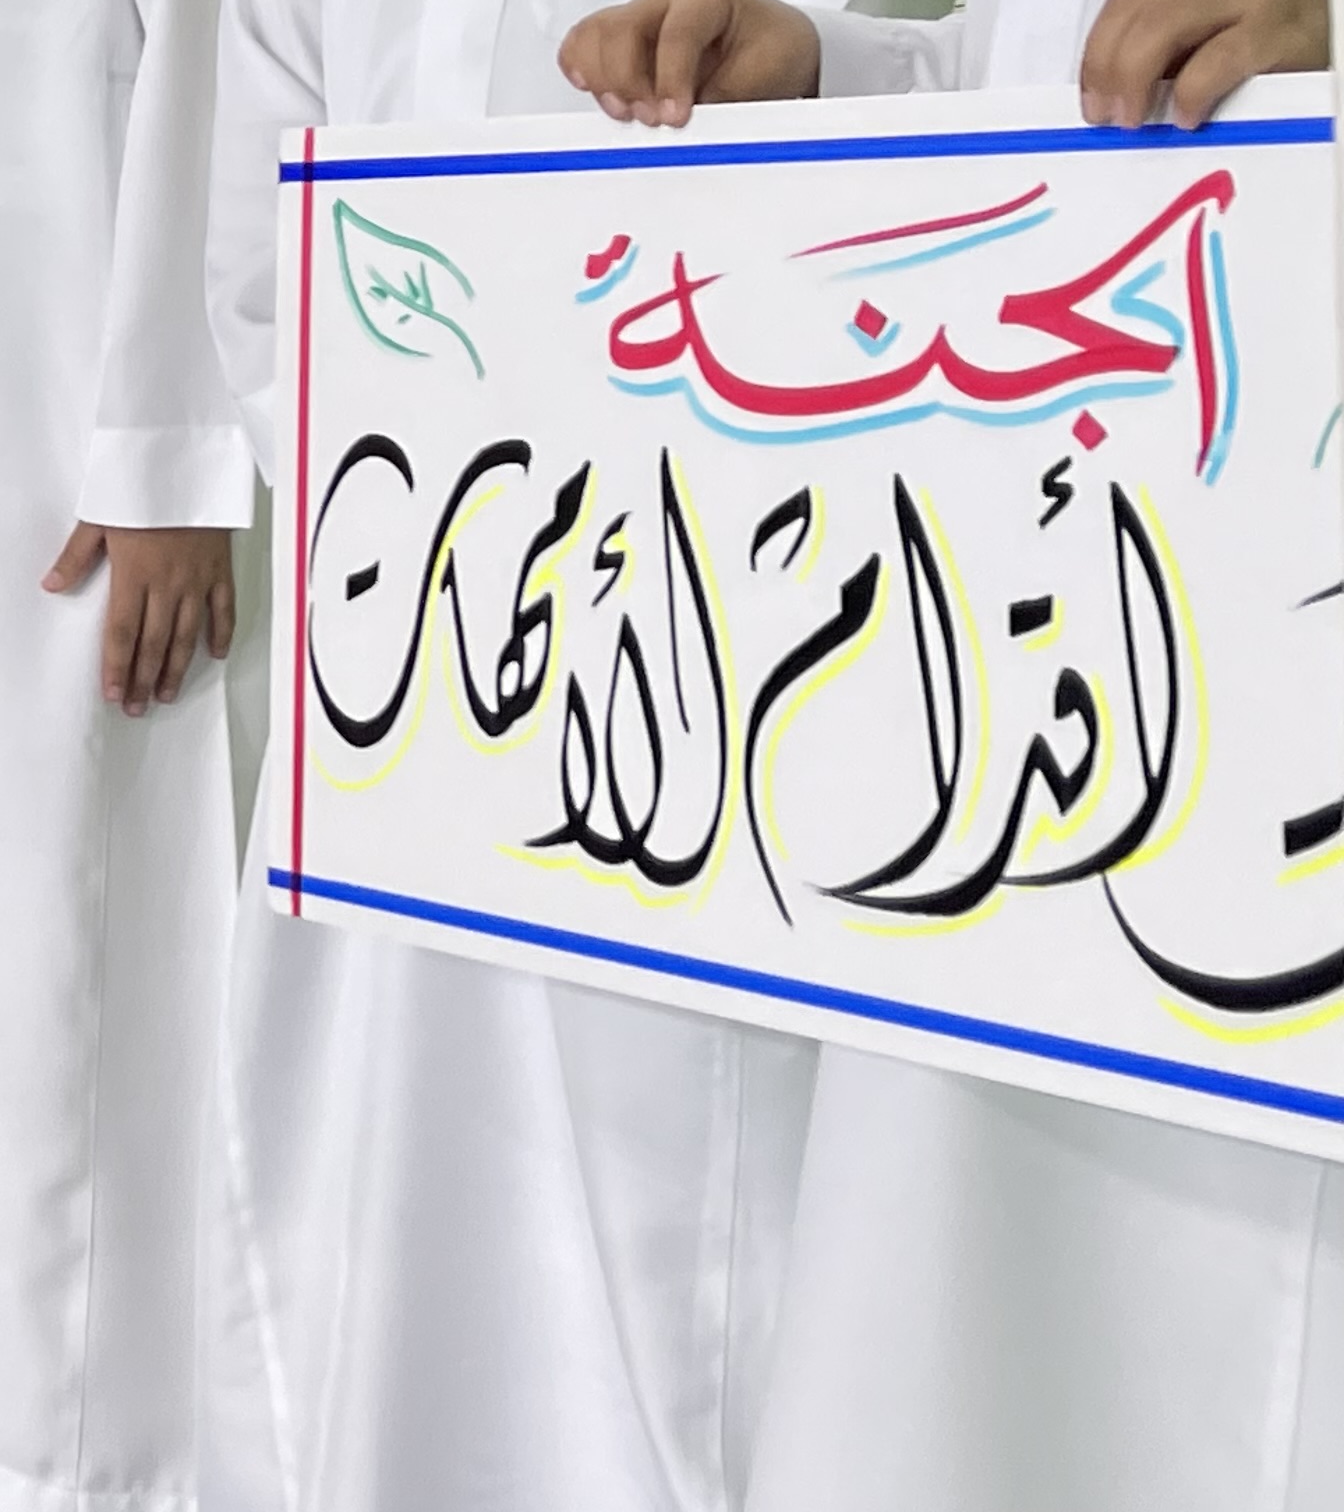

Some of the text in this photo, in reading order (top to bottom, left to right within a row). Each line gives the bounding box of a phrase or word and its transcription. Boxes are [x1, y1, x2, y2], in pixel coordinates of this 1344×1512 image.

[582, 169, 1238, 478] الجنة
[308, 432, 729, 888] الأمهات
[743, 455, 1180, 930] أقدام
